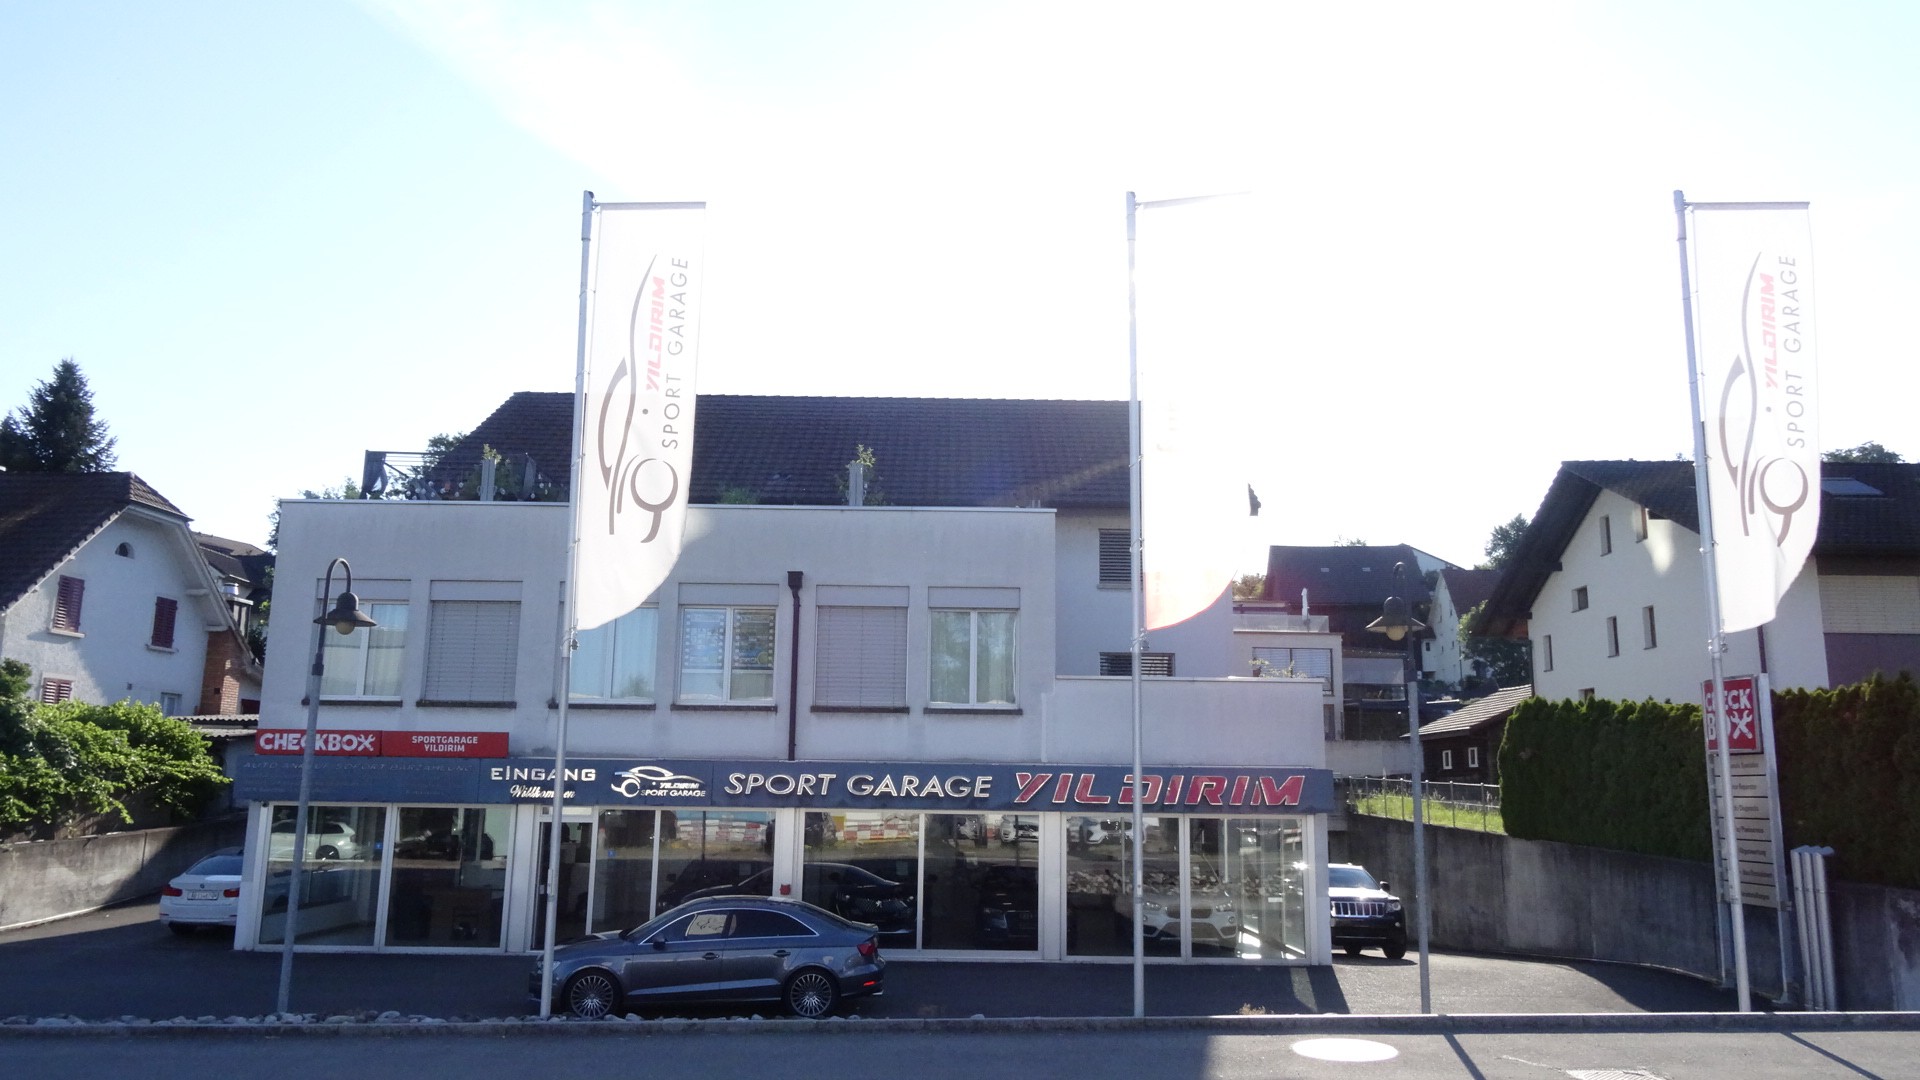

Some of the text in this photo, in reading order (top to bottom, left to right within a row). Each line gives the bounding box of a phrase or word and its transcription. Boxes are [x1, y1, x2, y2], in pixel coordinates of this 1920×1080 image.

[646, 276, 665, 392] YILDIRIM
[1760, 273, 1778, 389] YILDIRIM
[661, 257, 689, 449] SPORT GARAGE
[1778, 256, 1805, 448] SPORT GARAGE
[411, 735, 479, 744] SPORTGARAGE
[1706, 710, 1753, 740] BX
[424, 744, 465, 752] YILDIRIM
[510, 784, 576, 798] Willkomen
[640, 789, 706, 797] SPORT GARAGE
[724, 772, 993, 798] SPORT GARAGE
[1014, 772, 1306, 806] YILDIRIM
